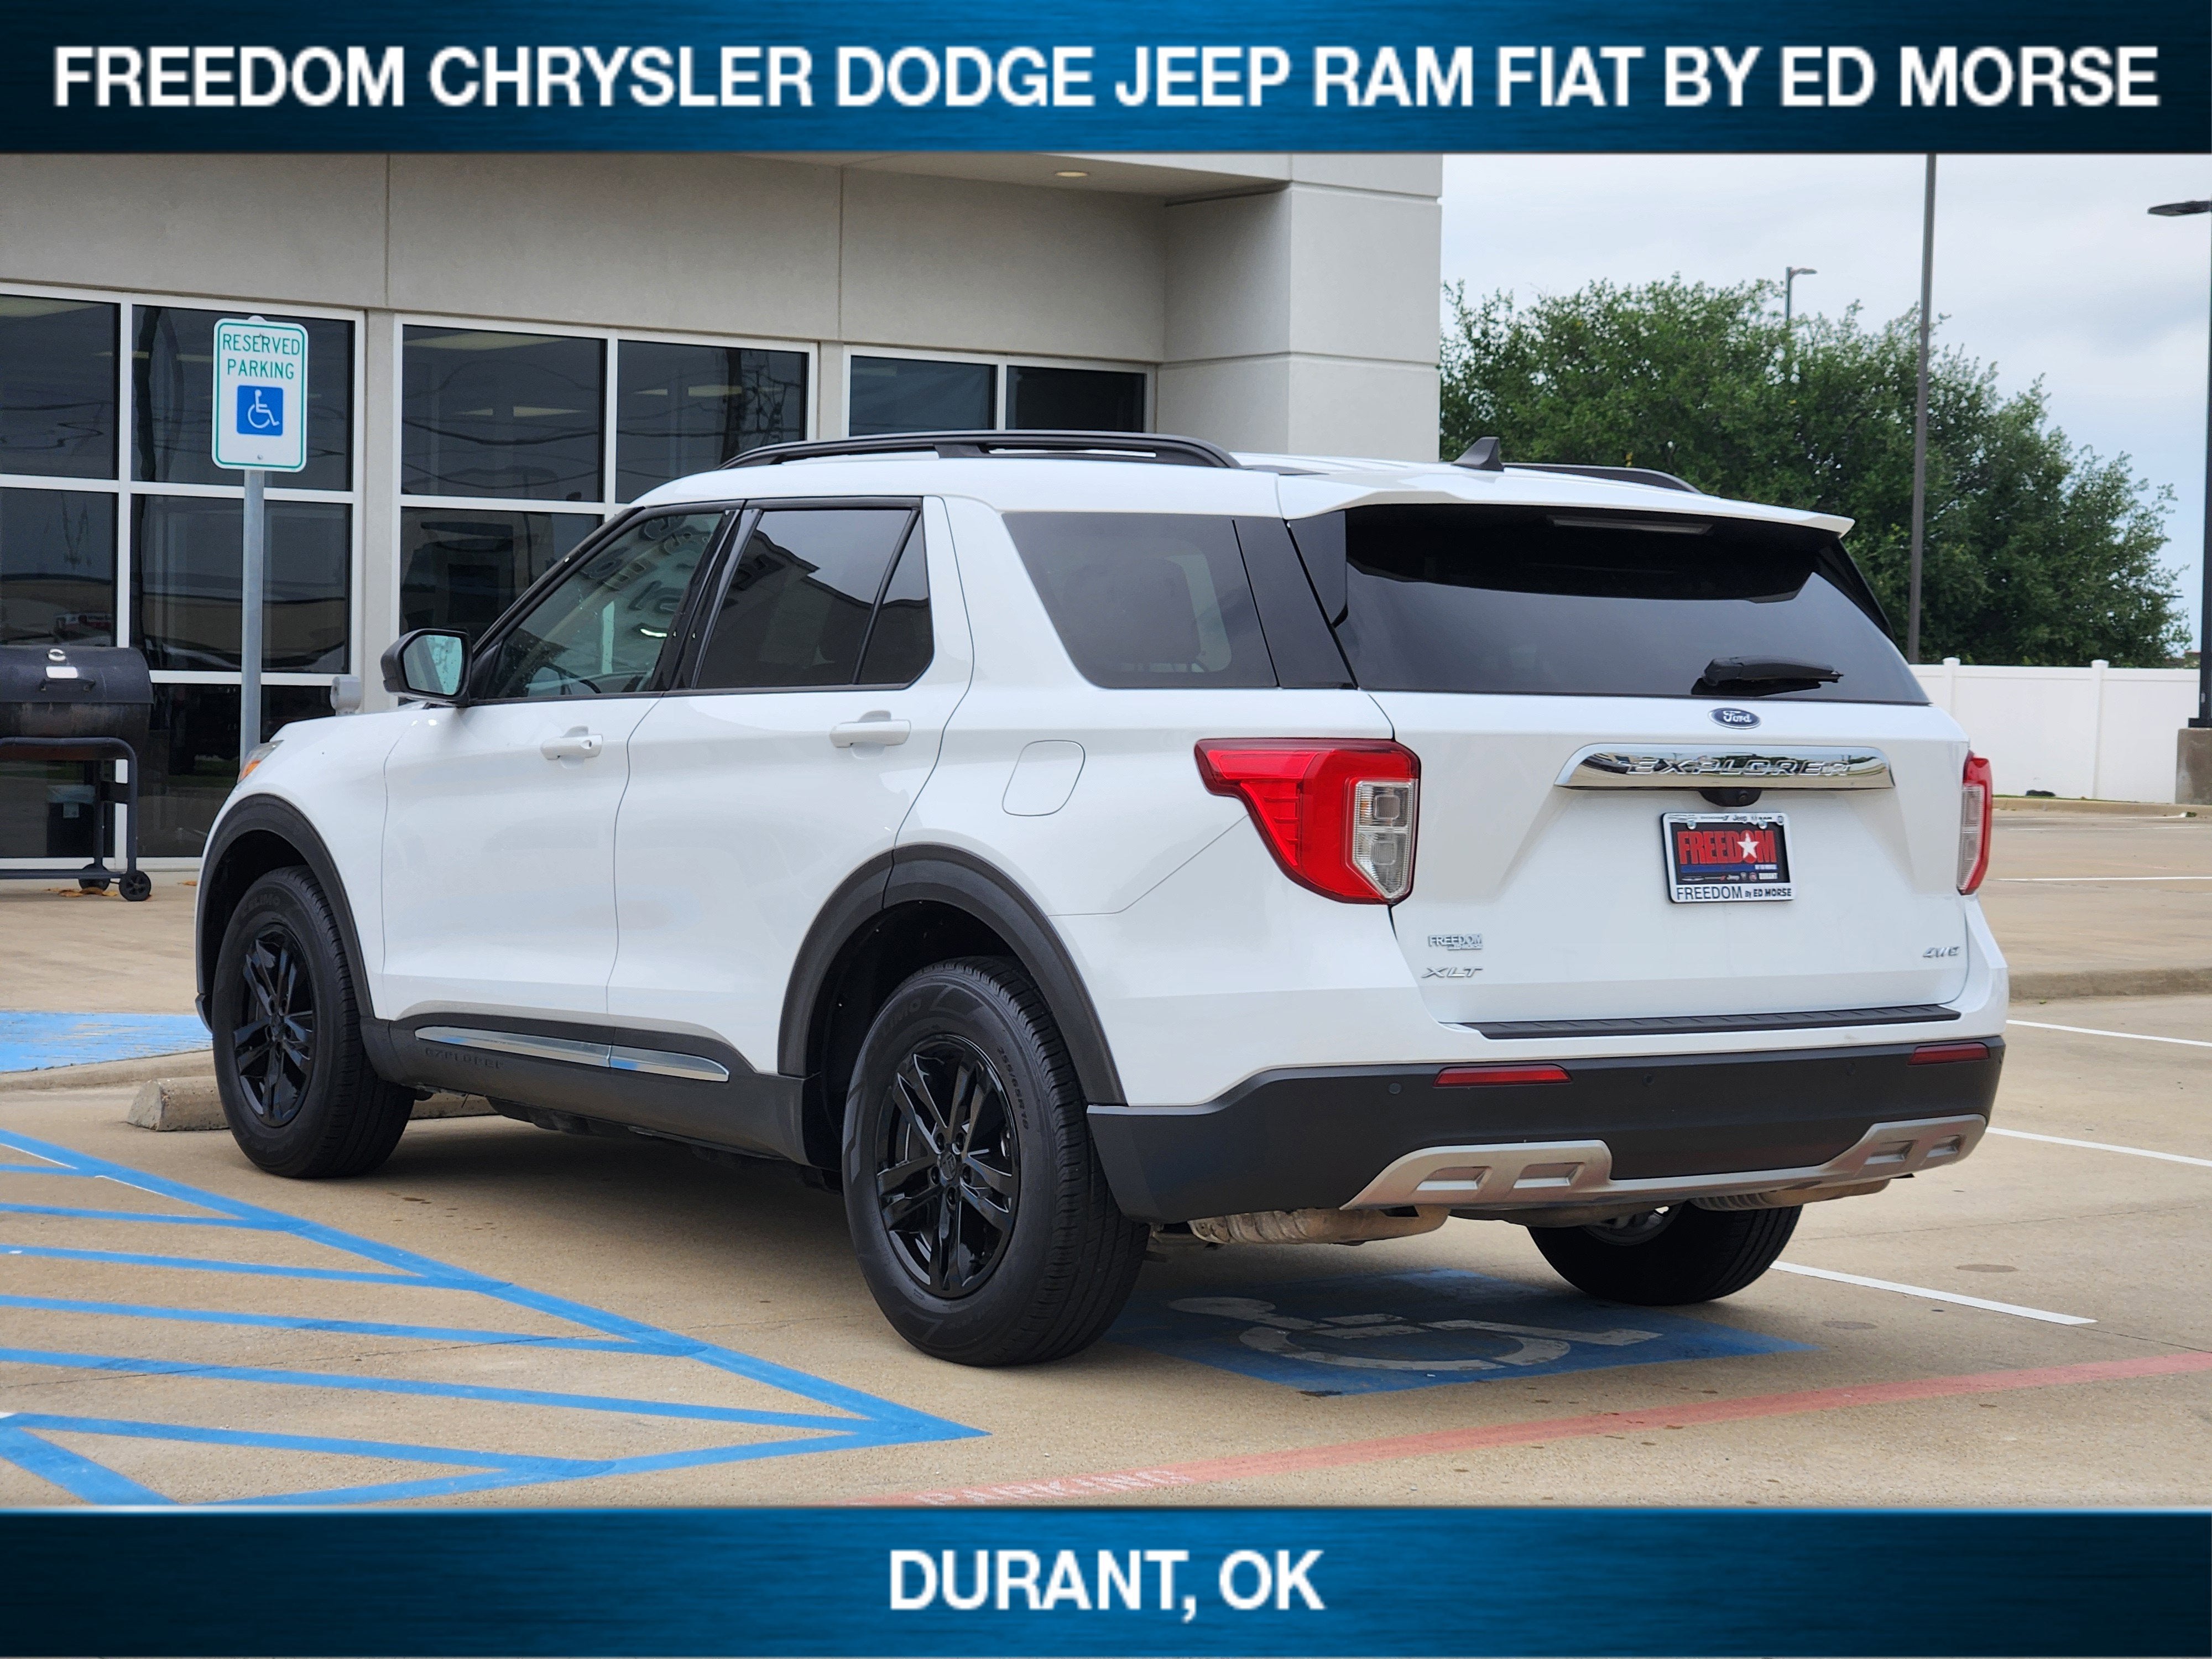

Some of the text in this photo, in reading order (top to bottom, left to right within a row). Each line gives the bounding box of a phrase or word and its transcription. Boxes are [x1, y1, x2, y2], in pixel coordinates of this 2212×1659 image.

[222, 333, 300, 354] RESERVED
[227, 359, 294, 379] PARKING
[1722, 710, 1752, 723] Ford
[1626, 757, 1850, 776] EXPLORER
[1676, 885, 1743, 900] FREEDOM
[1754, 889, 1763, 897] ED
[1765, 888, 1792, 897] MORSE
[1428, 933, 1483, 947] FREEDOM
[1421, 966, 1483, 978] XLT
